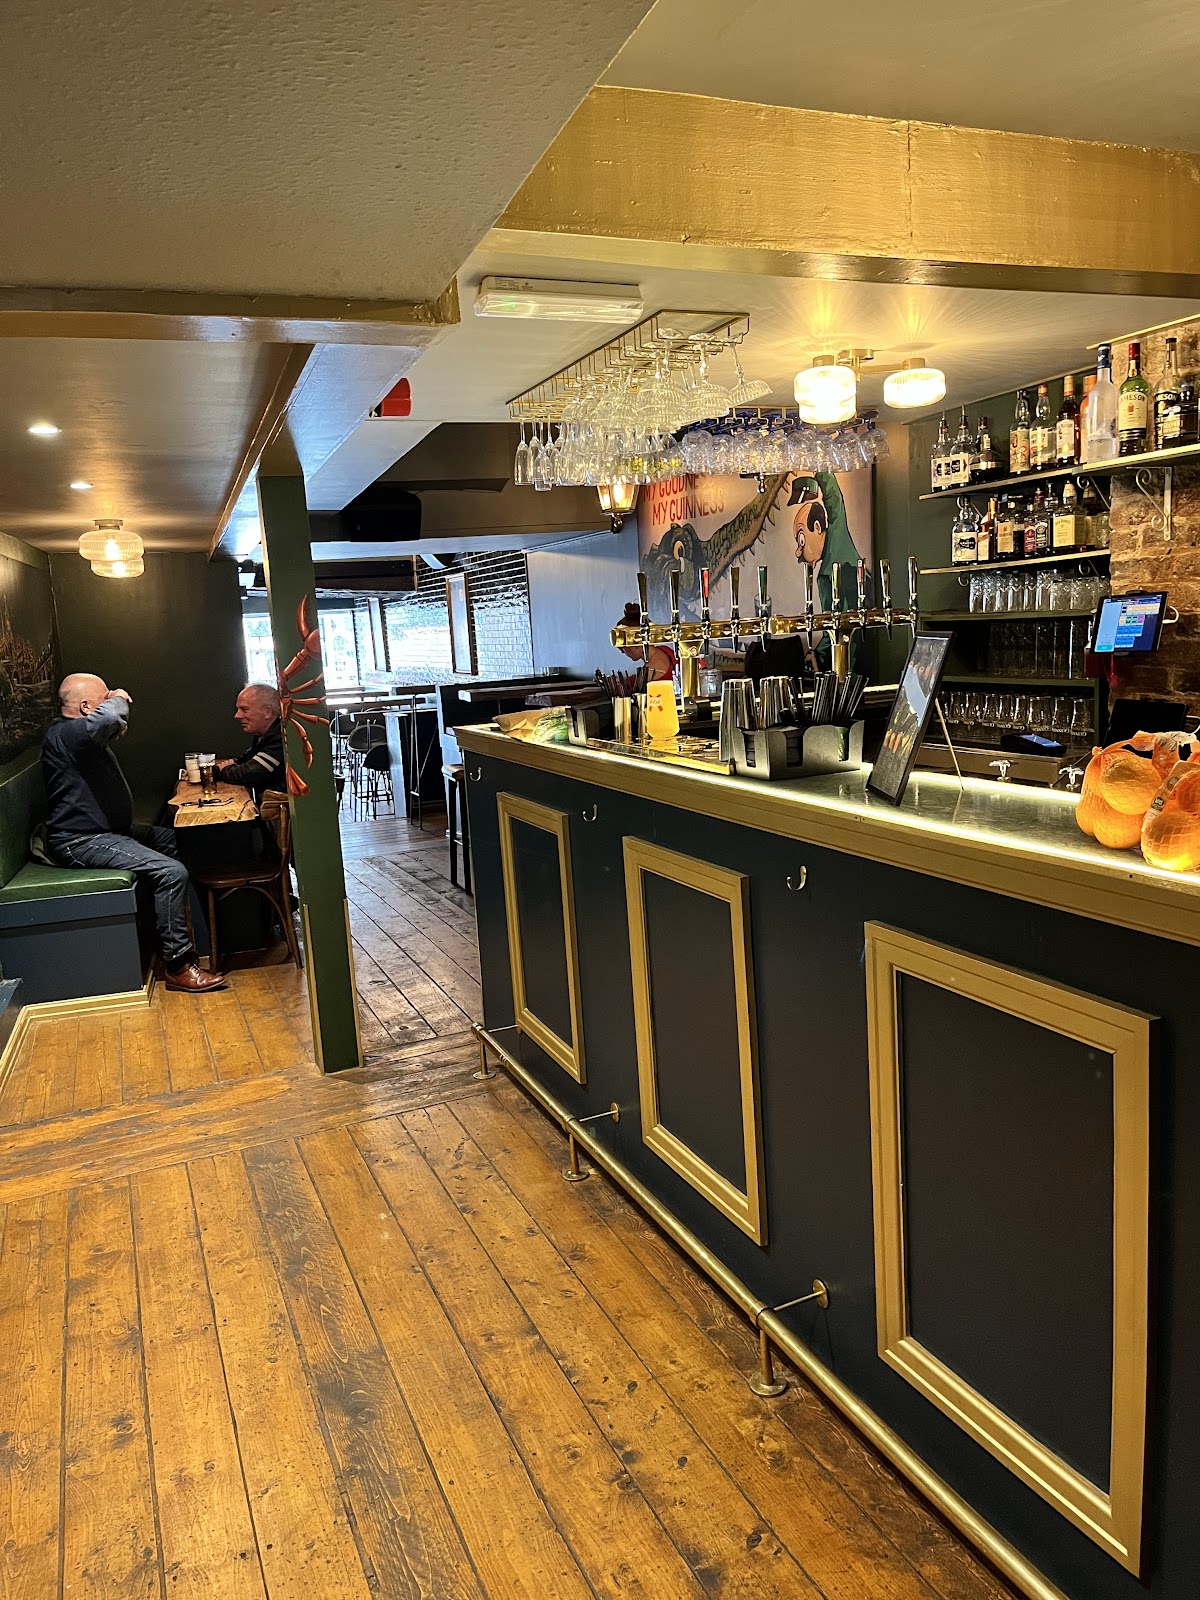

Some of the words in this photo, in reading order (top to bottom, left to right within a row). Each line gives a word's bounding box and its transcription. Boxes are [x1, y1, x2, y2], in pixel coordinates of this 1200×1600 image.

[644, 483, 657, 503] MY
[660, 473, 715, 498] GOODNE
[652, 500, 668, 527] MY
[669, 488, 725, 522] GUINNESS
